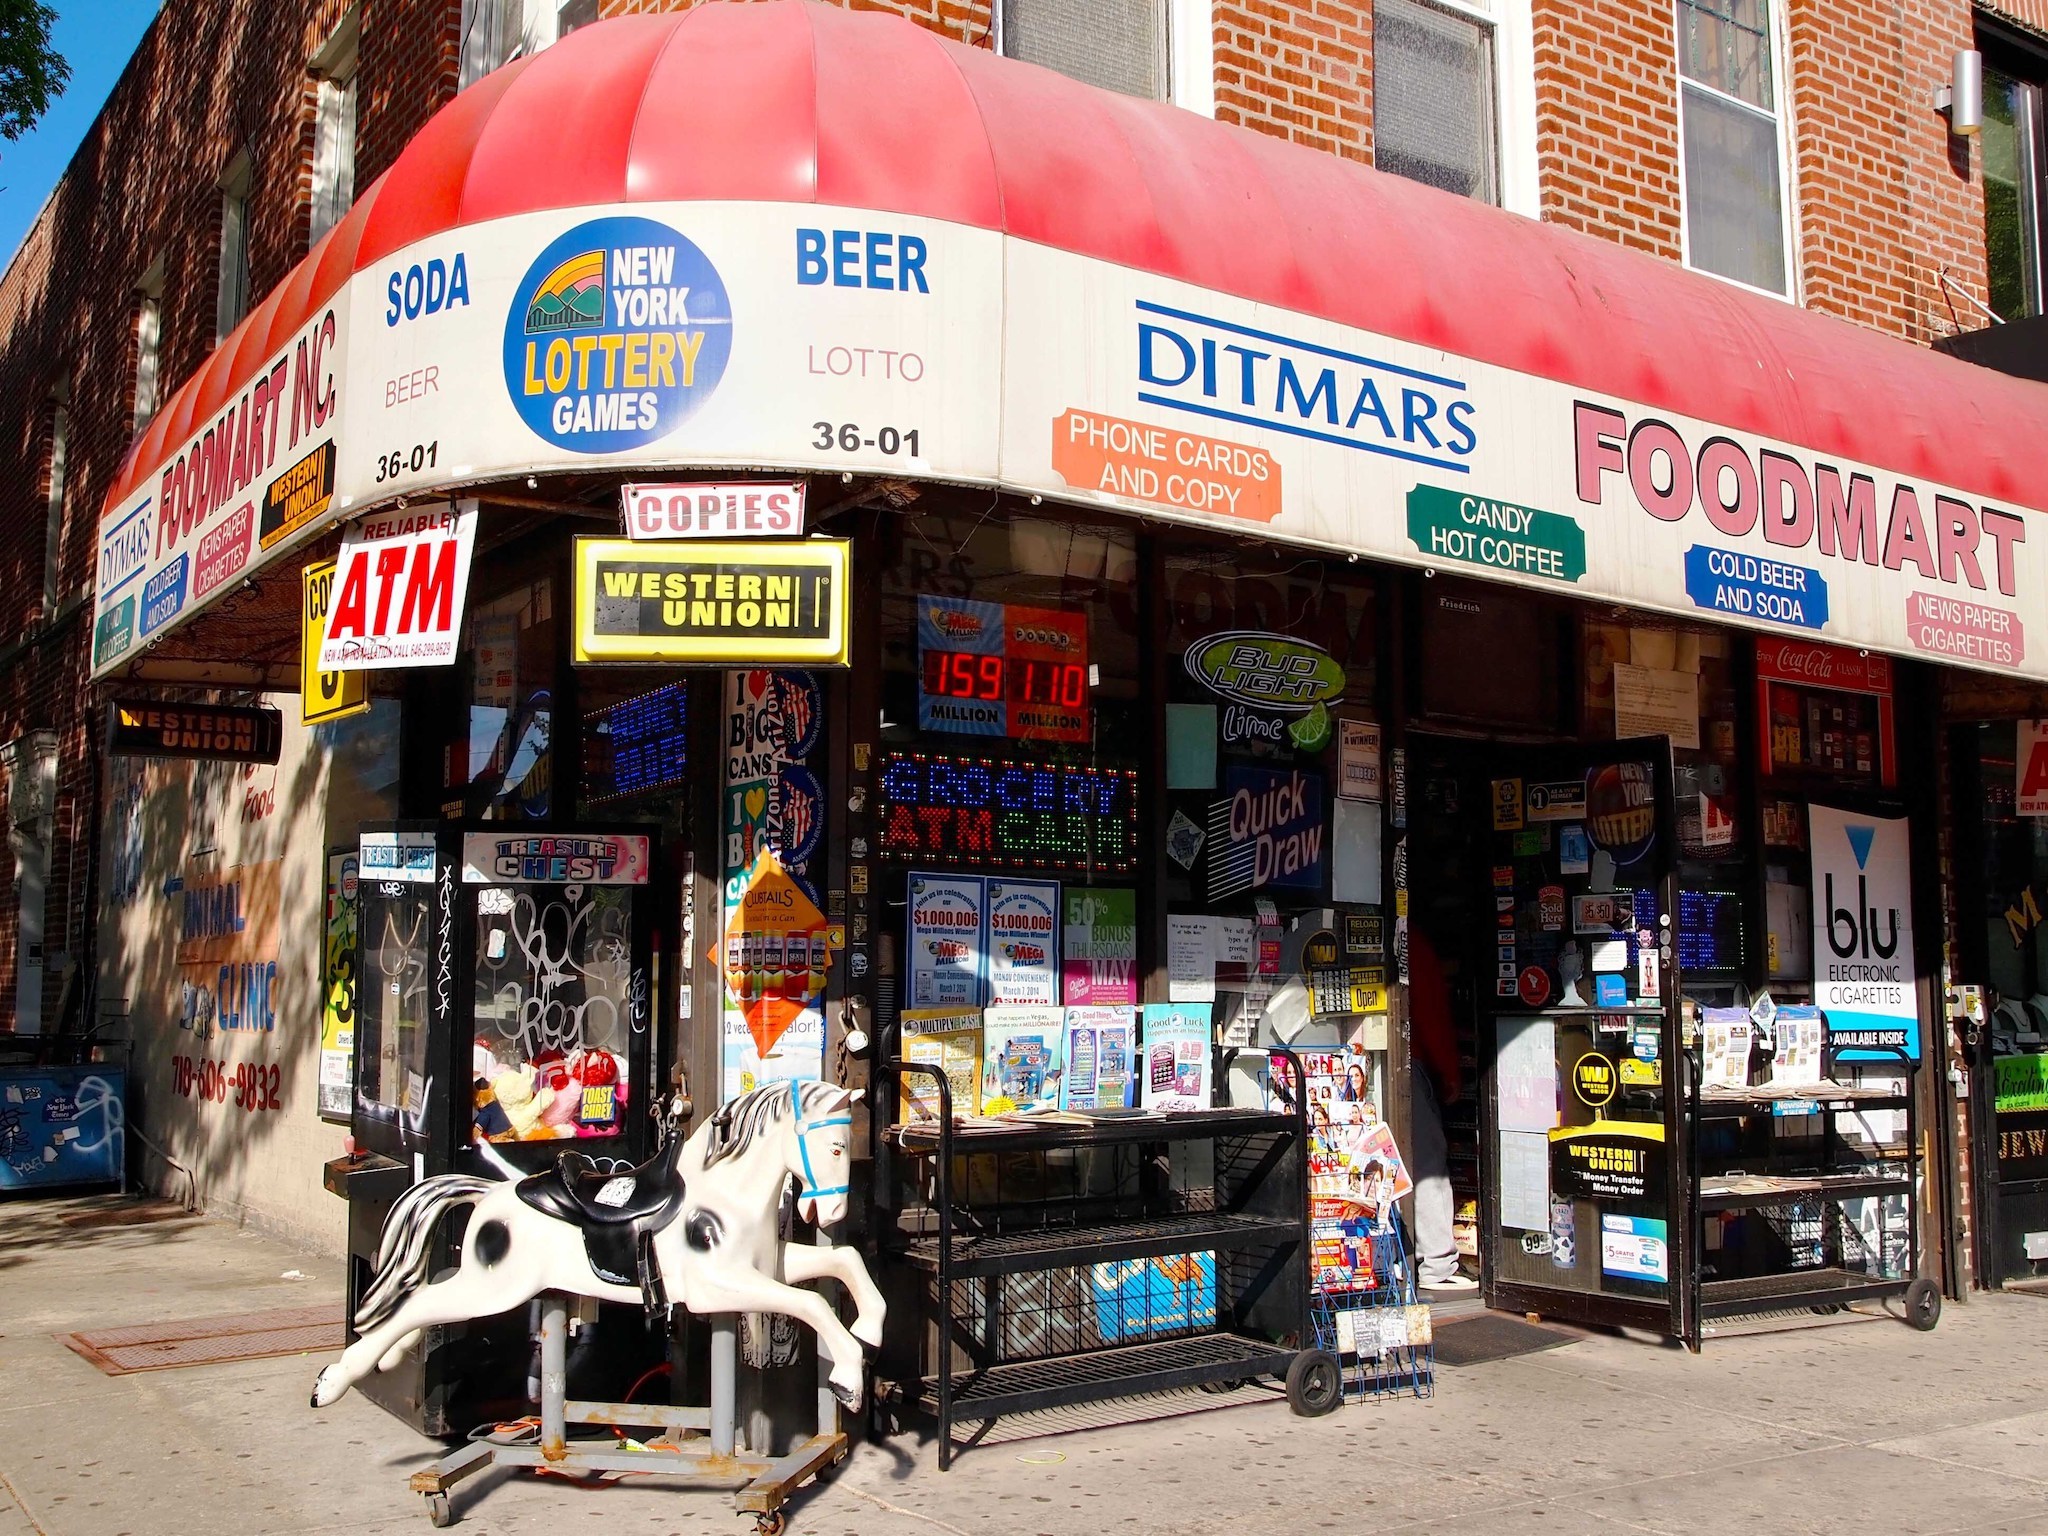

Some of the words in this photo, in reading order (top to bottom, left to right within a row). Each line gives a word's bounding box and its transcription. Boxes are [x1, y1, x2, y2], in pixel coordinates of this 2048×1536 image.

[613, 247, 676, 286] NEW
[796, 228, 930, 294] BEER
[386, 252, 470, 328] SODA
[613, 287, 690, 327] YORK
[524, 331, 705, 396] LOTTERY
[808, 345, 924, 382] LOTTO
[384, 364, 440, 409] BEER
[1138, 322, 1477, 456] DITMARS
[552, 393, 658, 435] GAMES
[155, 355, 287, 560] FOODMART
[288, 309, 336, 451] INC.
[811, 421, 920, 458] 36-01
[1070, 415, 1168, 463] PHONE
[1175, 438, 1270, 482] CARDS
[375, 440, 439, 484] 36-01
[271, 450, 318, 507] WESTERN
[1100, 462, 1160, 499] AND
[1166, 474, 1241, 514] COPY
[284, 479, 316, 522] UNION
[1573, 399, 2026, 598] FOODMART
[363, 512, 454, 541] RELIABLE
[1460, 498, 1534, 536] CANDY
[200, 529, 223, 563] NEWS
[222, 507, 248, 548] PAPER
[101, 512, 152, 588] DITMARS
[1431, 531, 1478, 560] HOT
[1480, 540, 1564, 578] COFFEE
[148, 570, 165, 602] COLD
[164, 559, 182, 588] BEER
[198, 542, 245, 595] CIGARETTES
[1708, 550, 1758, 582] COLD
[1760, 559, 1807, 594] BEER
[327, 539, 458, 640] ATM
[603, 571, 791, 600] WESTERN
[147, 604, 161, 630] AND
[160, 592, 177, 622] SODA
[662, 601, 791, 628] UNION
[1440, 597, 1480, 612] Friedrich
[1715, 584, 1753, 615] AND
[1756, 593, 1805, 624] SODA
[1918, 596, 1962, 626] NEWS
[1965, 605, 2011, 636] PAPER
[107, 627, 129, 659] COFFEE
[323, 649, 336, 663] NEW
[393, 643, 409, 659] CALL
[1921, 627, 2013, 663] CIGARETTES
[1229, 645, 1319, 677] BUD
[1756, 650, 1774, 664] Enjoy
[1836, 662, 1864, 677] CLASSIC
[737, 672, 746, 706] I
[938, 653, 1003, 700] 159
[1211, 666, 1328, 699] LIGHT
[120, 708, 250, 734] WESTERN
[930, 705, 999, 723] MILLION
[1018, 711, 1081, 730] MILLION
[1223, 705, 1283, 742] Lime
[162, 730, 251, 751] UNION
[1350, 734, 1378, 746] WINNER!
[729, 752, 772, 779] CANS
[1619, 762, 1645, 781] NEW
[241, 768, 277, 825] Food
[732, 791, 743, 827] I
[1229, 770, 1306, 843] Quick
[884, 805, 992, 850] ATM
[362, 845, 404, 868] TREASURE
[405, 846, 436, 870] CHEST
[496, 838, 618, 858] TREASURE
[1253, 824, 1322, 888] Draw
[495, 856, 616, 881] CHEST
[183, 881, 246, 940] ANIMAL
[745, 888, 794, 909] CLUBTAILS
[944, 889, 978, 912] celebrating
[1019, 893, 1052, 916] celebrating
[1540, 902, 1563, 913] Sold
[779, 914, 795, 923] Can
[914, 909, 979, 927] $1,000,006
[992, 913, 1052, 931] $1,000,006
[1261, 914, 1277, 926] MAY
[1351, 920, 1380, 928] RELOAD
[1540, 912, 1563, 923] Here
[1825, 872, 1899, 960] blu
[933, 927, 954, 935] Millions
[955, 928, 976, 936] Winner!
[994, 930, 1008, 938] Mega
[1009, 930, 1029, 938] Millions
[1030, 931, 1050, 939] Winner!
[1092, 926, 1131, 942] BONUS
[1223, 926, 1232, 934] We
[1351, 935, 1380, 944] HERE
[938, 942, 969, 957] MEGA
[1014, 945, 1044, 960] MEGA
[1071, 942, 1132, 959] THURSDAYS
[1229, 945, 1248, 953] greeting
[1013, 973, 1049, 983] CONVENIENCE
[1069, 977, 1086, 991] Quick
[1091, 959, 1131, 986] MAY
[1829, 964, 1901, 983] ELECTRONIC
[218, 960, 277, 1033] CLINIC
[940, 995, 965, 1003] Astoria
[1003, 986, 1021, 995] March
[1027, 987, 1040, 996] 2014
[1074, 984, 1091, 1000] Draw
[1356, 988, 1378, 1010] Open
[1829, 987, 1902, 1005] CIGARETTES
[919, 1017, 954, 1034] MULTIPLY
[1082, 1011, 1095, 1019] Good
[1096, 1011, 1112, 1020] Things
[1147, 1016, 1171, 1028] Good
[1184, 1017, 1205, 1027] Luck
[1833, 1032, 1878, 1046] AVAILABLE
[1879, 1031, 1905, 1045] INSIDE
[1579, 1065, 1609, 1083] WU
[1582, 1082, 1609, 1090] WESTERN
[582, 1086, 614, 1105] TOAST
[1568, 1144, 1634, 1161] WESTERN
[1588, 1157, 1634, 1173] UNION
[1582, 1171, 1609, 1183] Money
[1609, 1174, 1644, 1186] Transfer
[1592, 1182, 1620, 1194] Money
[1620, 1185, 1645, 1196] Order
[1315, 1208, 1335, 1217] World
